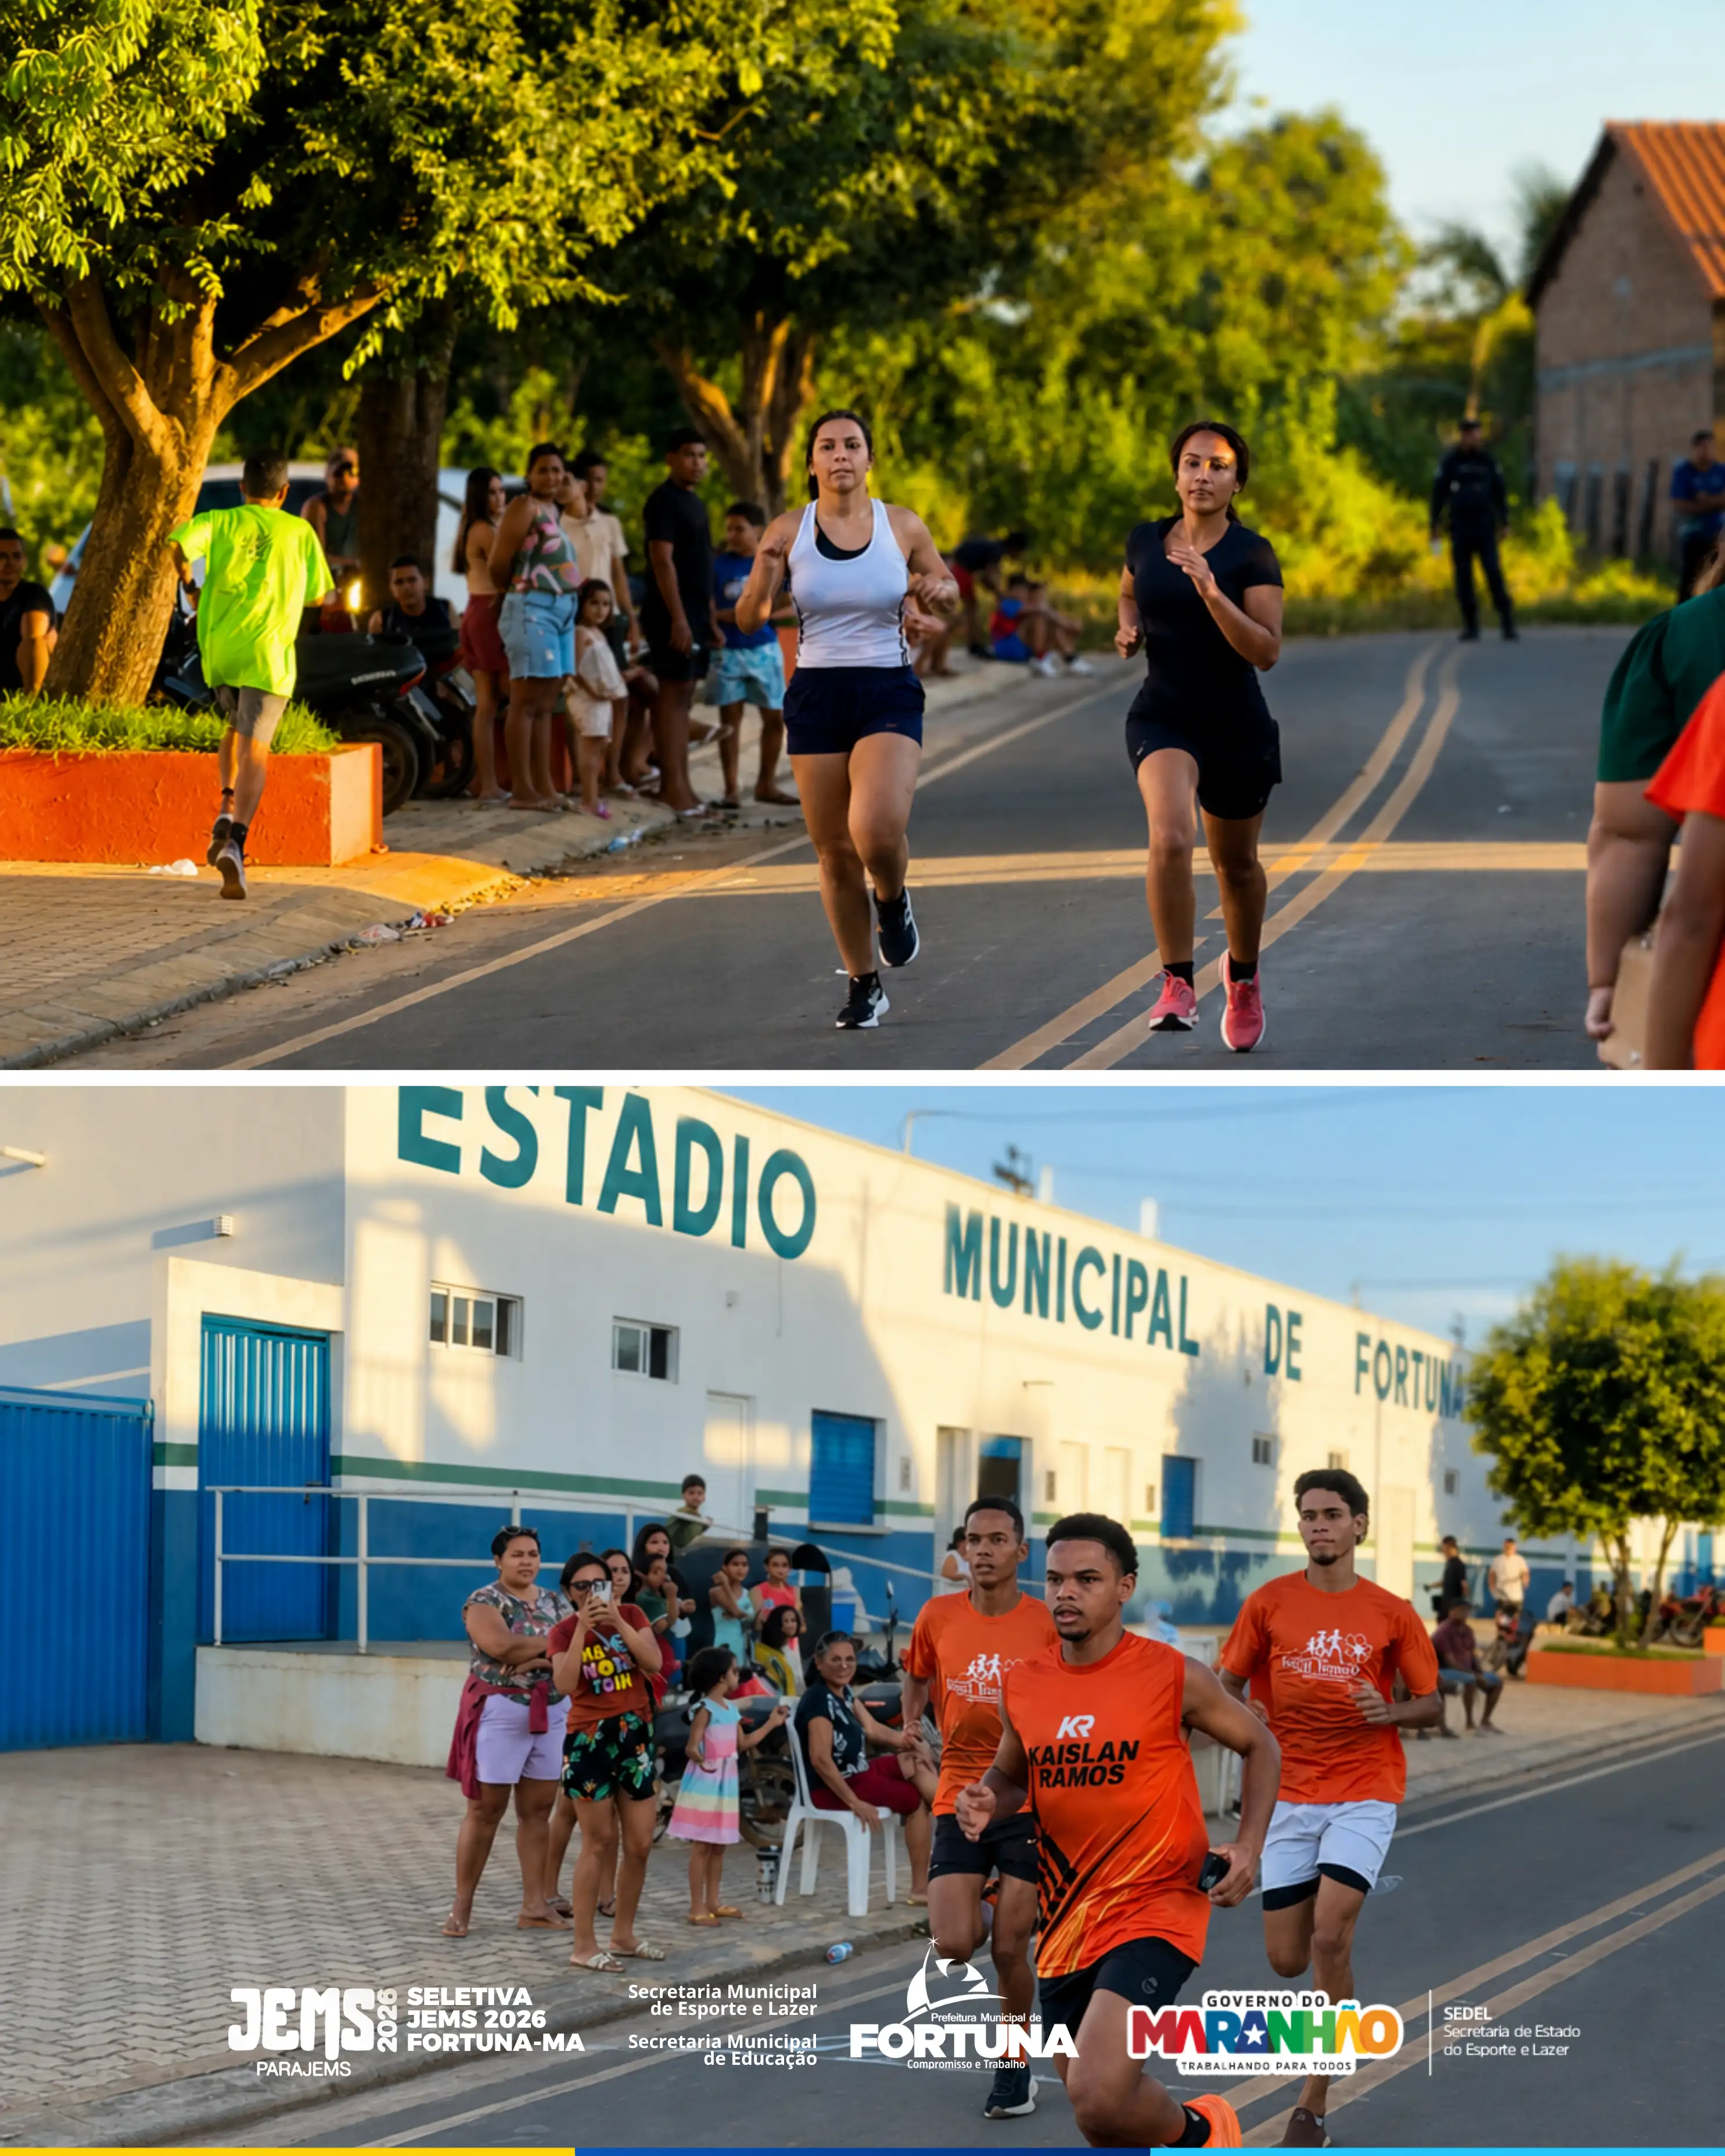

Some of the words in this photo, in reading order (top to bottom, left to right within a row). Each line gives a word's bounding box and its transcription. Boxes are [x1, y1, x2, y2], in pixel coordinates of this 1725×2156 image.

[943, 1200, 1199, 1357] MUNICIPAL
[1264, 1302, 1303, 1381] DE
[1056, 1715, 1095, 1739] KR
[1029, 1740, 1140, 1767] KAISLAN
[1039, 1764, 1126, 1788] RAMOS
